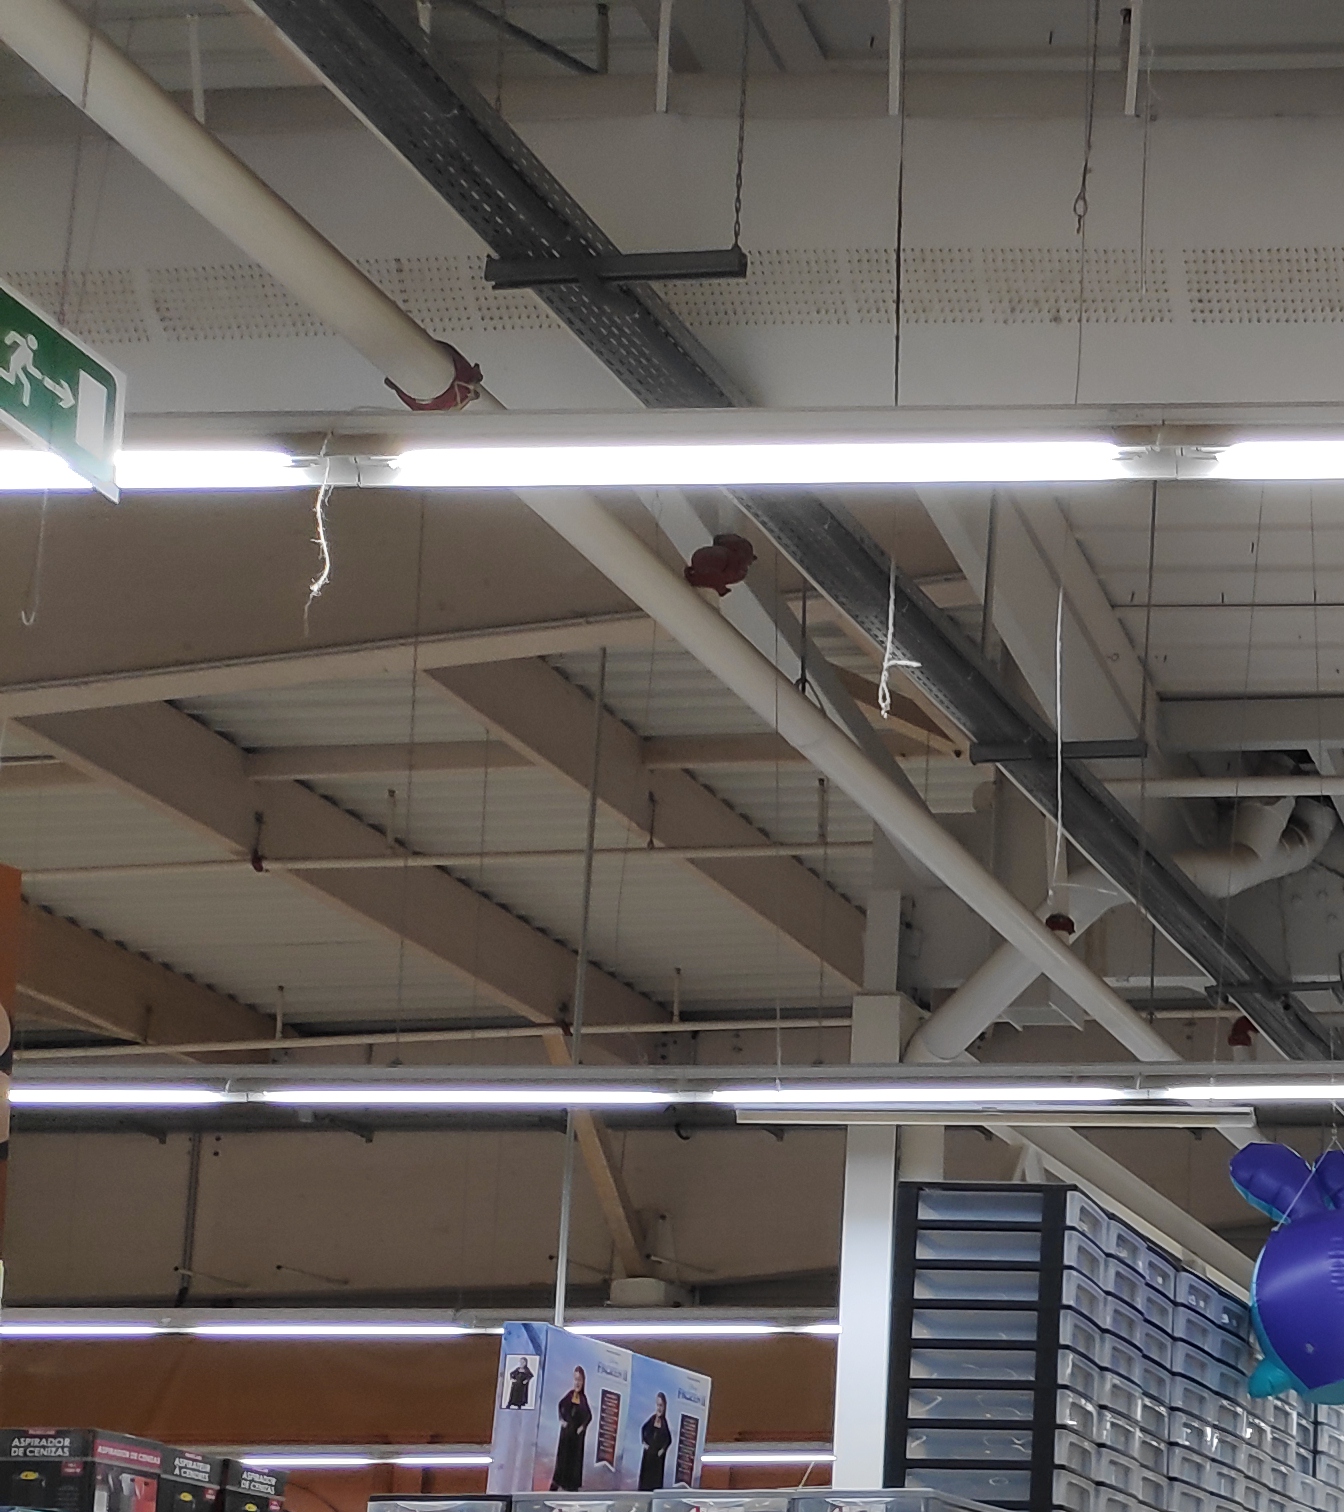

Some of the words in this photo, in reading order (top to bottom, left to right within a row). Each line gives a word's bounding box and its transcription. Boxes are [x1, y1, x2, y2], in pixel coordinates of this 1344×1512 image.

[11, 1437, 71, 1447] ASPIRADOR
[11, 1448, 25, 1458] DE
[27, 1447, 70, 1458] CENIZAS
